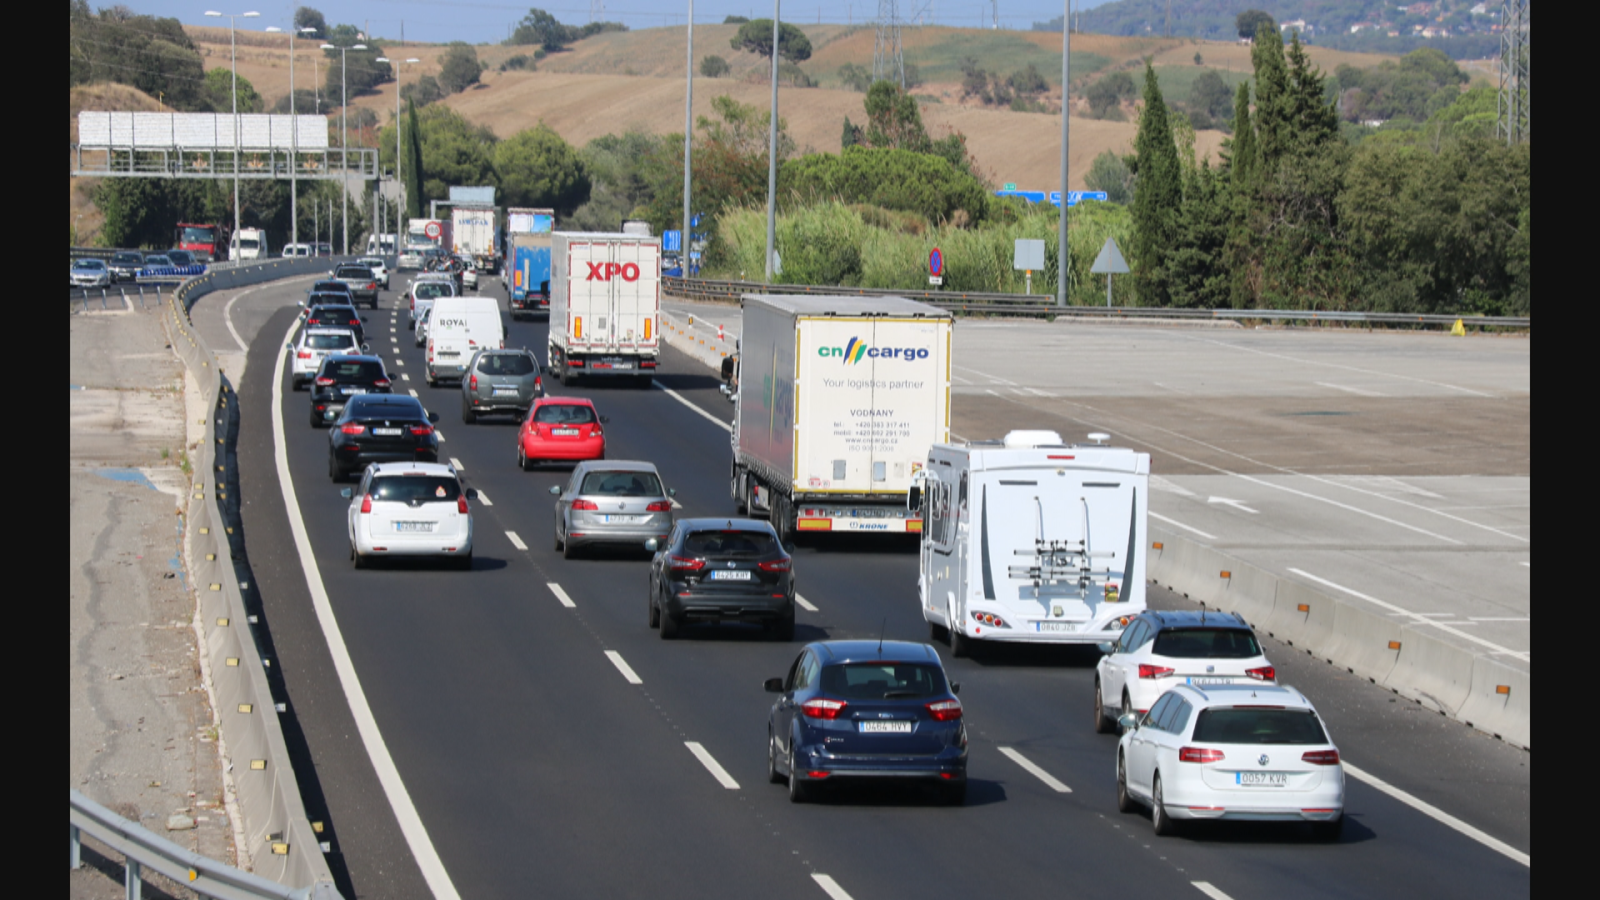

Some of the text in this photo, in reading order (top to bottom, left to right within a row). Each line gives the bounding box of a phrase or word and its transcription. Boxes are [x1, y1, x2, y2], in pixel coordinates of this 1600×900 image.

[586, 261, 640, 282] XPO
[818, 346, 929, 361] cn cargo
[823, 378, 924, 390] Your logistics partner
[1242, 773, 1287, 784] 0057 KVR
